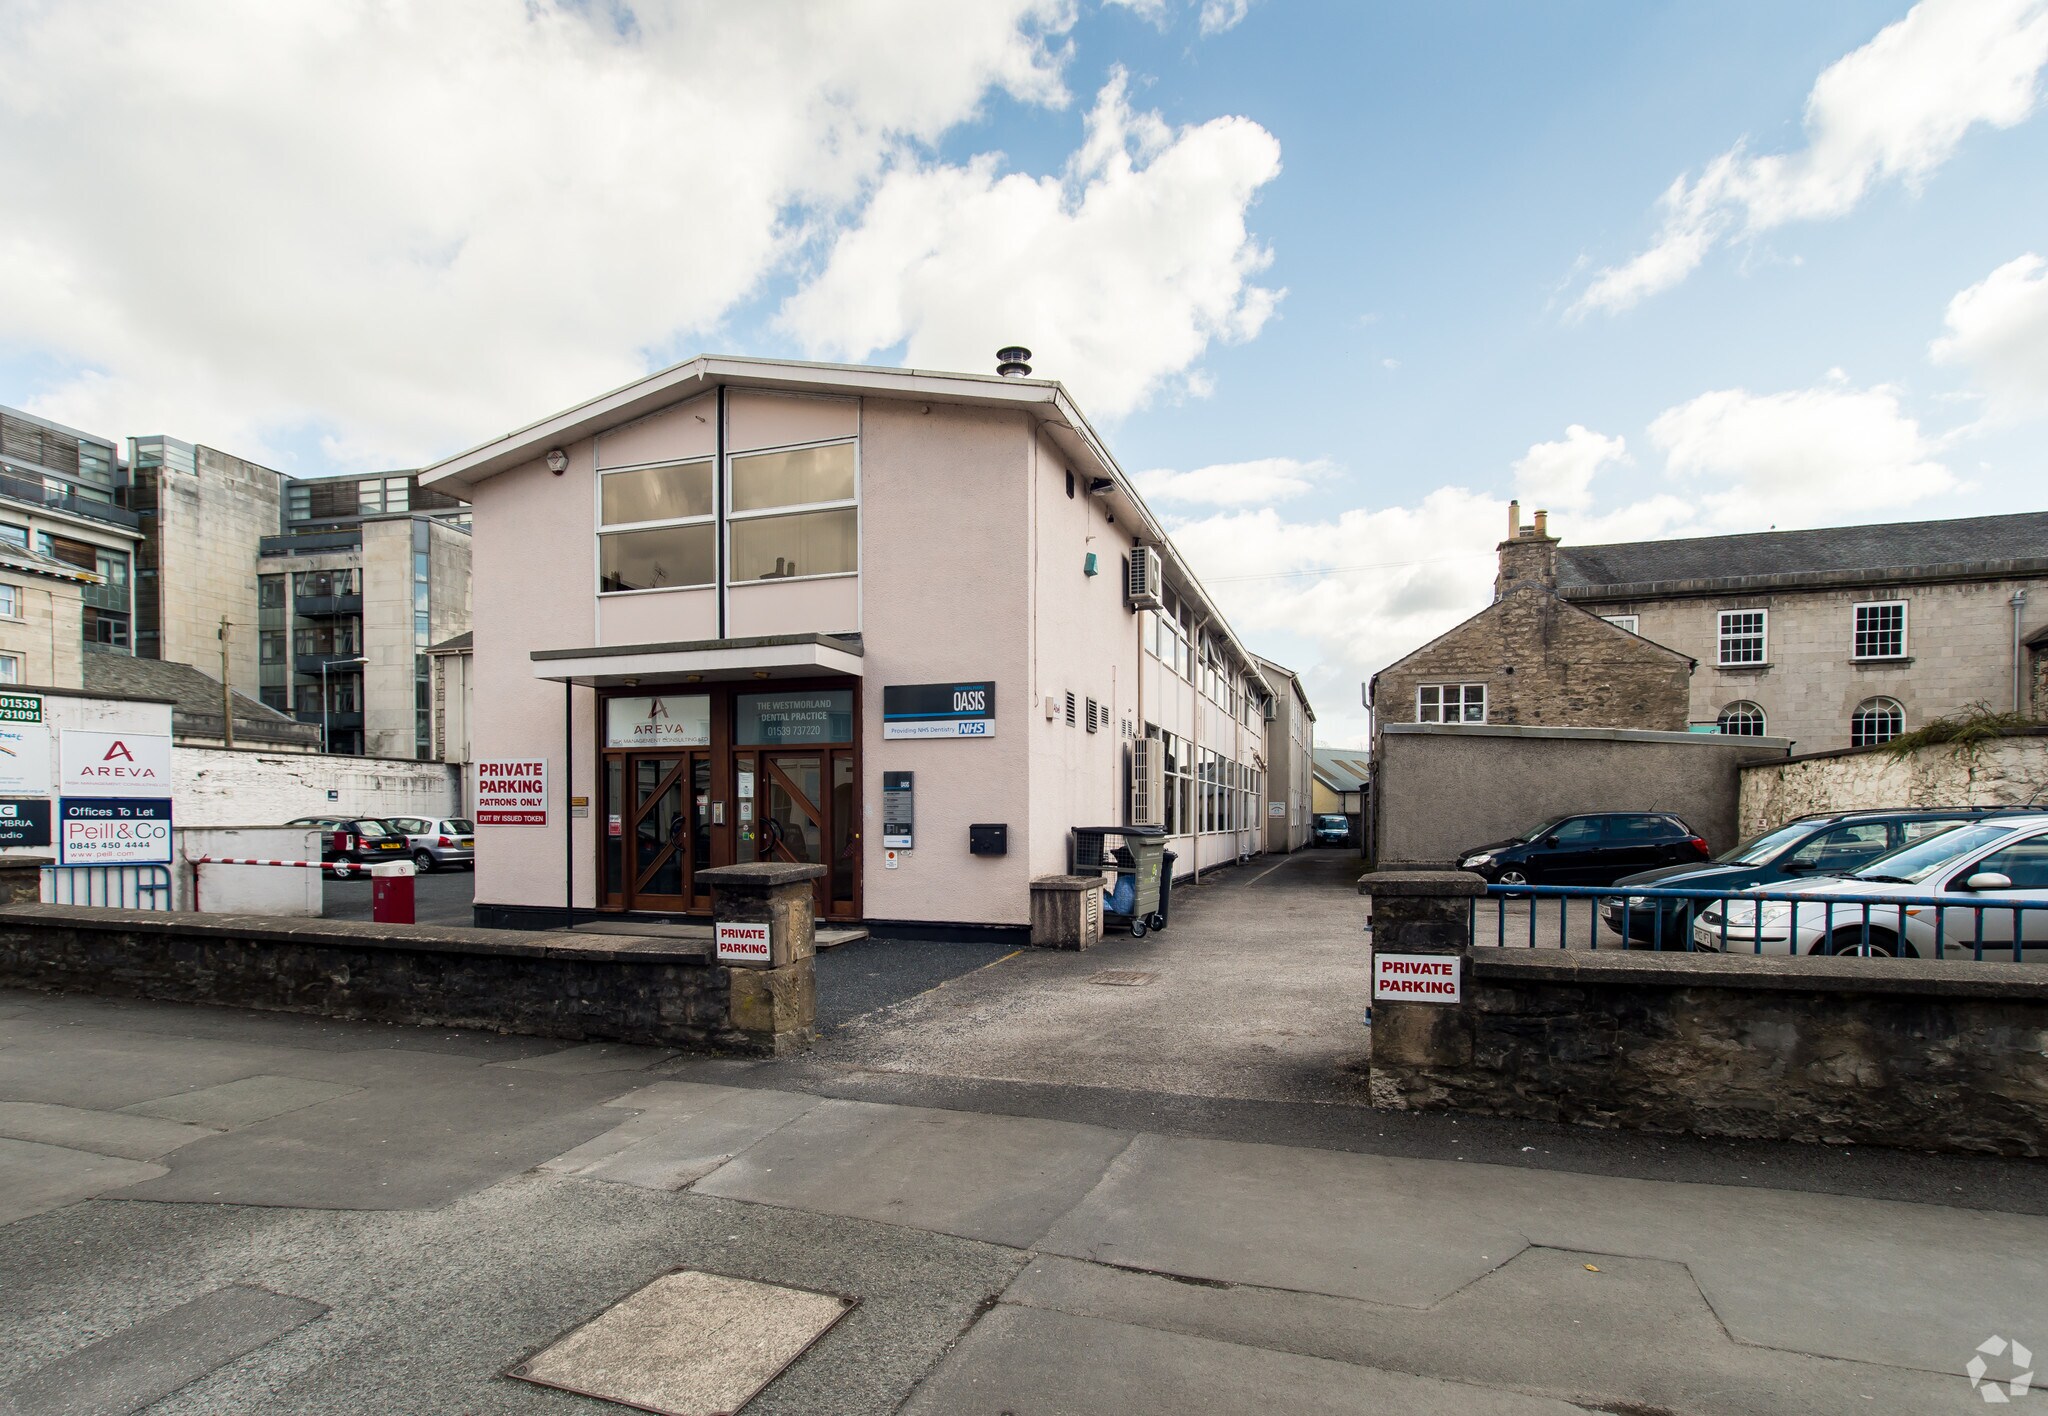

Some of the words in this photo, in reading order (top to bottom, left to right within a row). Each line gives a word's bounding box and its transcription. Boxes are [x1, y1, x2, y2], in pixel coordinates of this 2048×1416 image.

[0, 698, 38, 710] 01539
[757, 702, 771, 710] THE
[772, 700, 832, 710] WESTMORLAND
[953, 691, 985, 711] OASIS
[761, 713, 789, 722] DENTAL
[791, 712, 827, 721] PRACTICE
[634, 724, 684, 734] AREVA
[767, 726, 791, 736] 01539
[793, 725, 821, 736] 737220
[959, 723, 985, 734] NHS
[80, 766, 155, 777] AREVA
[479, 763, 543, 776] PRIVATE
[479, 780, 543, 793] PARKING
[479, 798, 517, 806] PATRONS
[520, 798, 543, 806] ONLY
[69, 807, 112, 816] Offices
[118, 807, 131, 816] To
[136, 807, 154, 816] Let
[69, 822, 166, 839] Peill&Co
[721, 929, 765, 939] PRIVATE
[720, 943, 768, 954] PARKING
[1382, 961, 1453, 975] PRIVATE
[1379, 980, 1455, 994] PARKING
